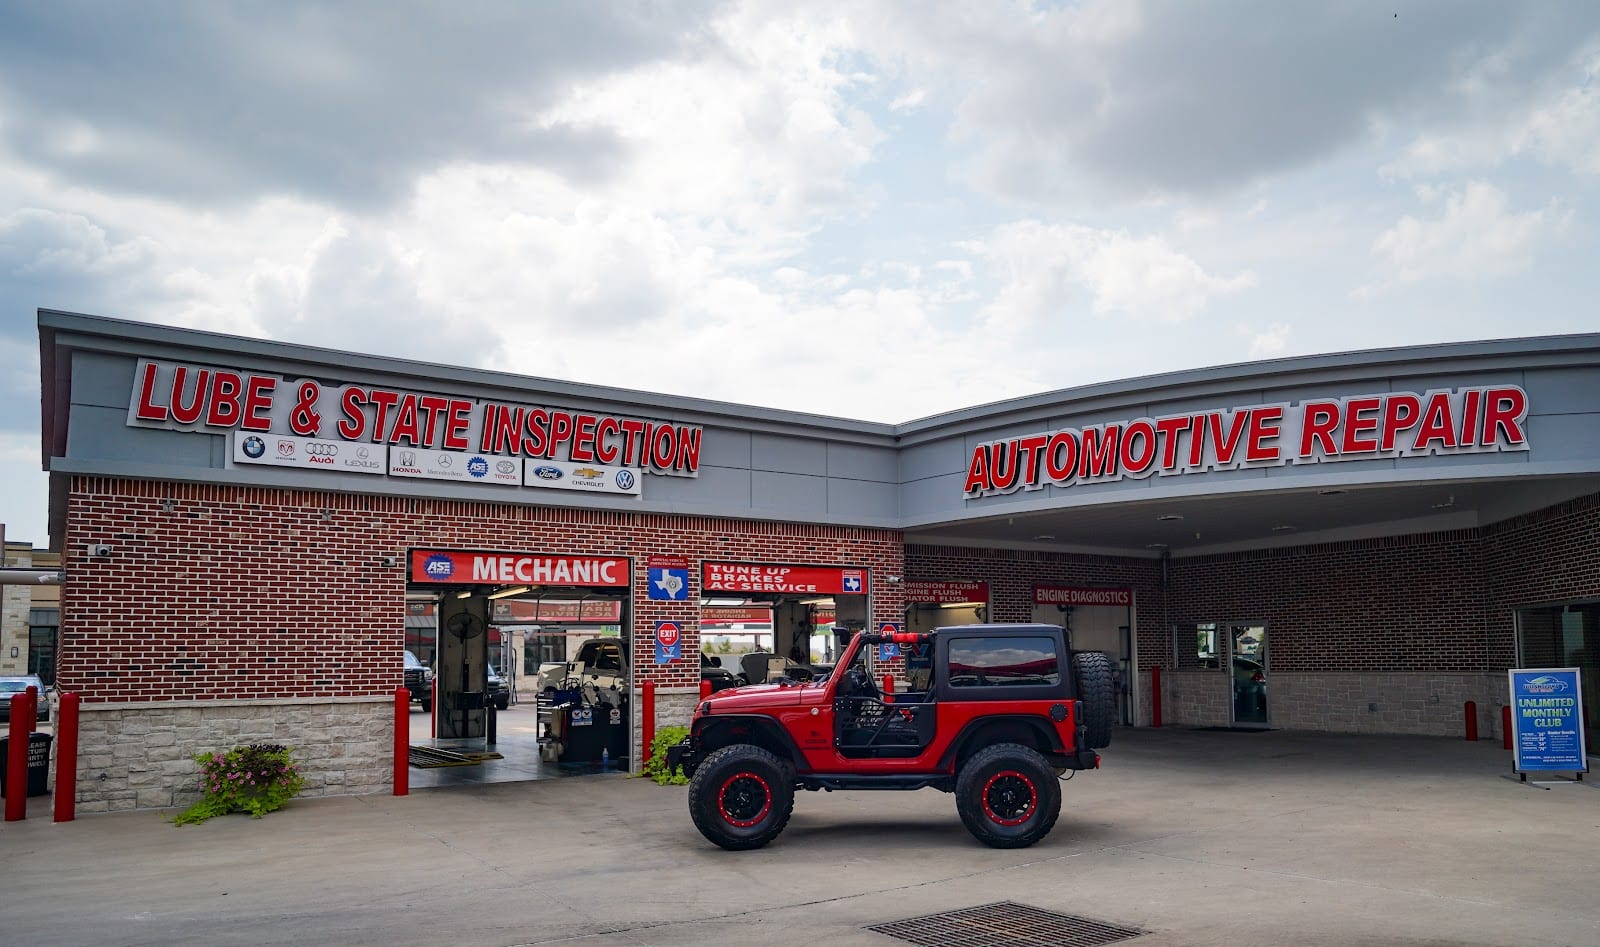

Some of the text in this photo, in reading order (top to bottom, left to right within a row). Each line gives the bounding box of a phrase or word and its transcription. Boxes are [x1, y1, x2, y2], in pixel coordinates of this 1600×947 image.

[136, 362, 703, 472] LUBE & STATE INSPECTION
[963, 386, 1529, 494] AUTOMOTIVE REPAIR
[309, 455, 334, 464] Audi
[344, 459, 380, 468] LEXUS
[392, 466, 422, 474] HONDA
[539, 468, 559, 479] Ford
[572, 480, 605, 488] CHEVROLET
[427, 561, 450, 571] ASE
[472, 556, 617, 583] MECHANIC
[710, 564, 791, 575] TUNE UP
[710, 573, 785, 583] BRAKES
[710, 581, 817, 592] AC SERVICE
[1036, 588, 1129, 603] ENGINE DIAGNOSTICS
[660, 629, 677, 638] EXIT
[1518, 698, 1575, 708] UNLIMITED
[1522, 708, 1572, 718] MONTHLY
[1534, 718, 1563, 727] CLUB
